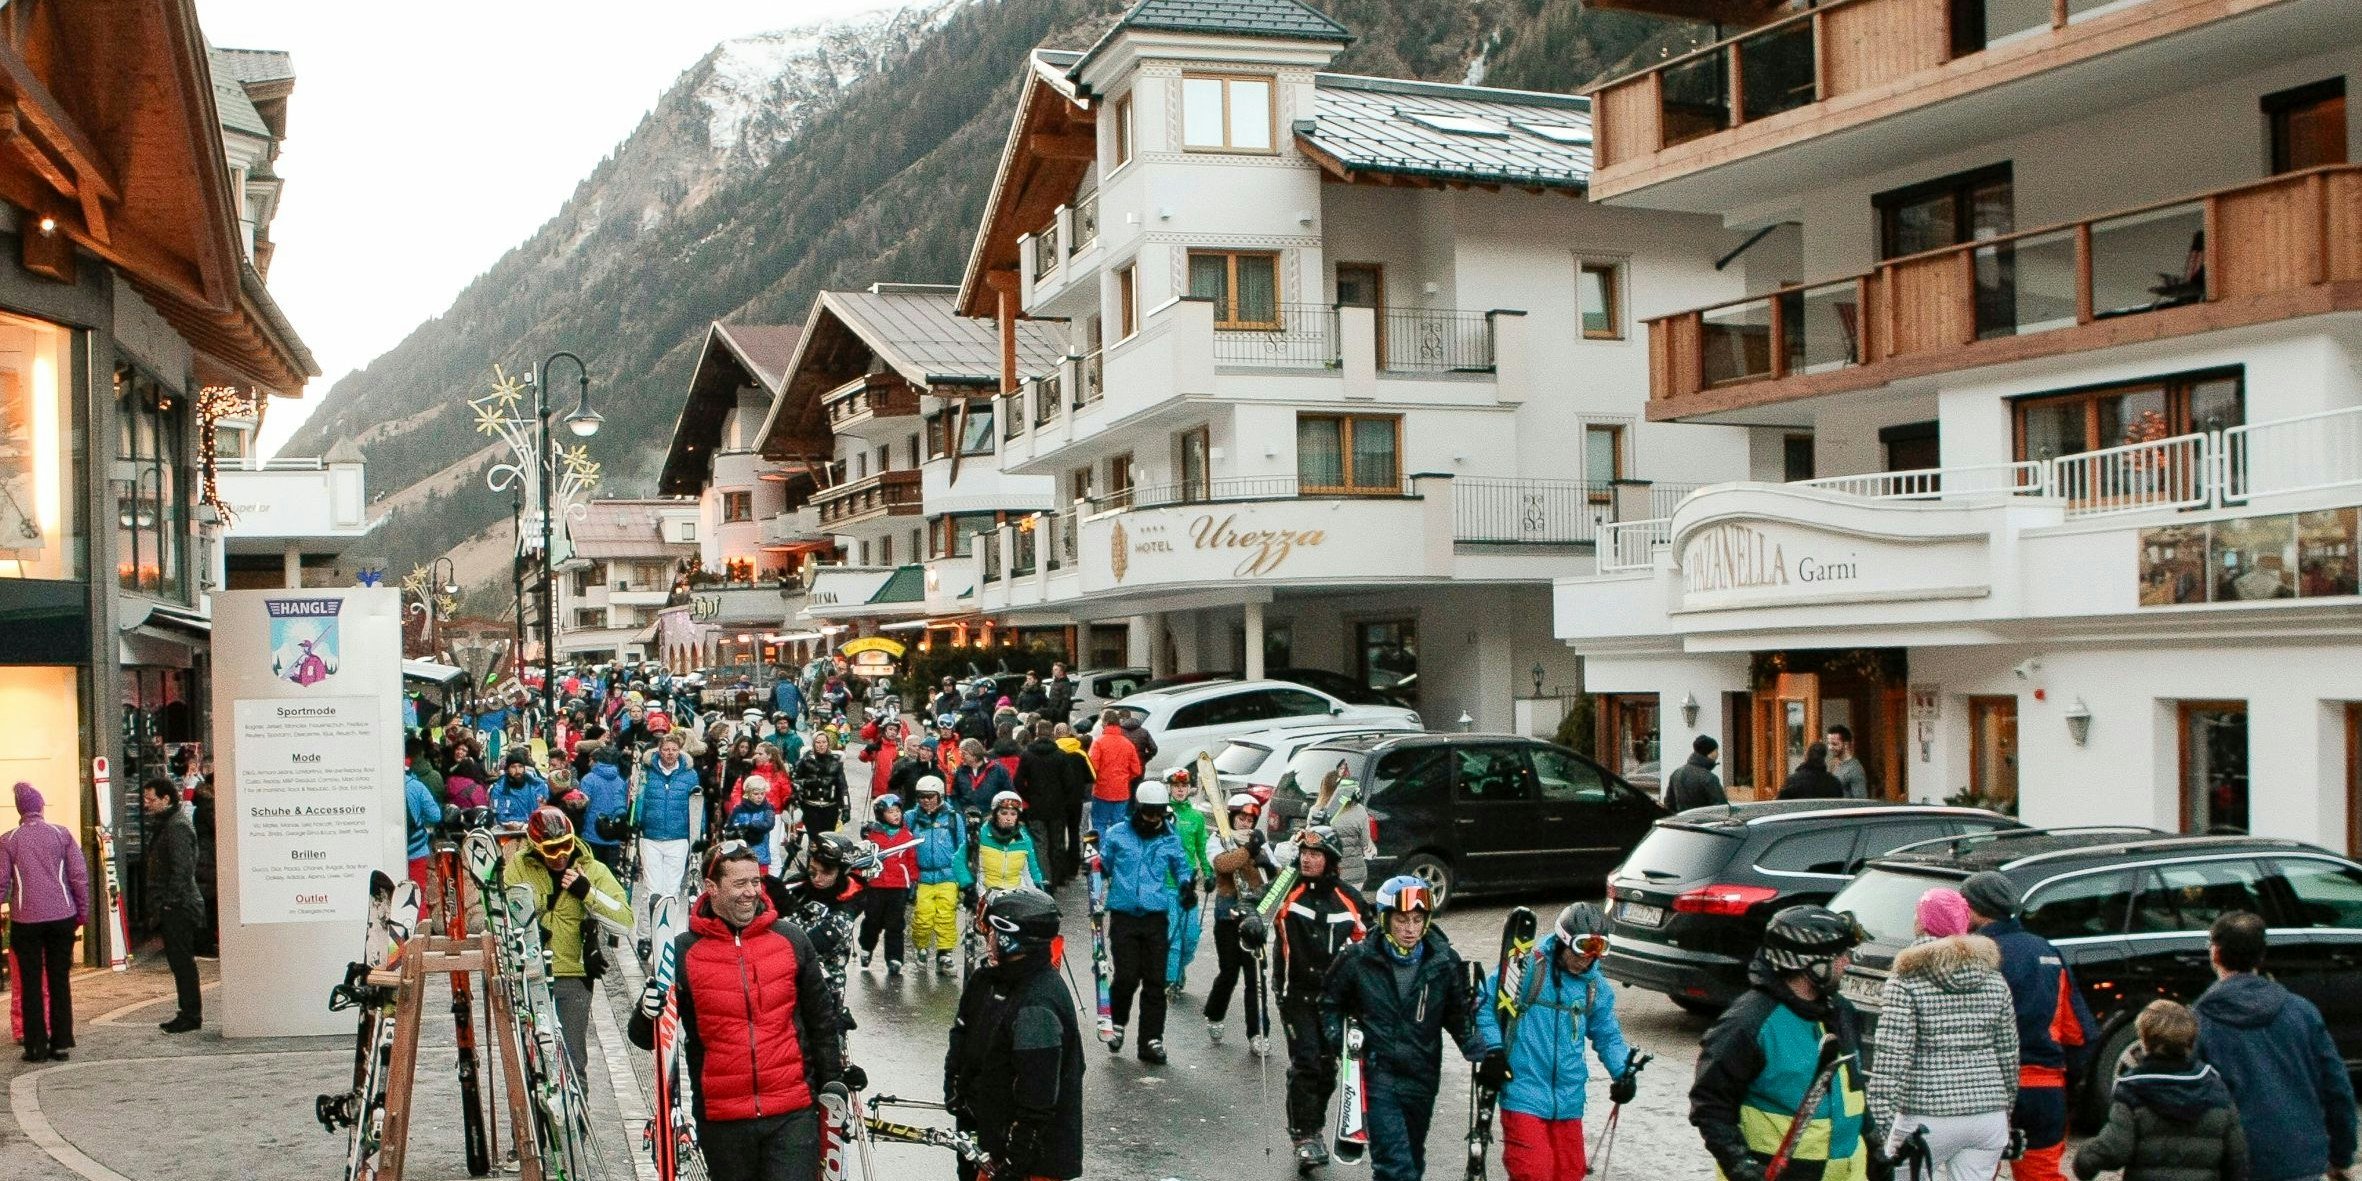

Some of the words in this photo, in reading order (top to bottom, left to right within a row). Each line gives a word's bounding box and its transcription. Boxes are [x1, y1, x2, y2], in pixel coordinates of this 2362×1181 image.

[1135, 541, 1173, 553] HOTEL
[1189, 513, 1326, 577] Urezza
[1799, 552, 1857, 582] Garni
[280, 601, 328, 615] HANGL
[276, 706, 337, 718] Sportmode
[291, 753, 322, 763] Mode
[251, 806, 291, 817] Schuhe
[294, 806, 302, 815] &
[305, 804, 366, 815] Accessoire
[291, 850, 327, 860] Brillen
[295, 893, 329, 904] Outlet
